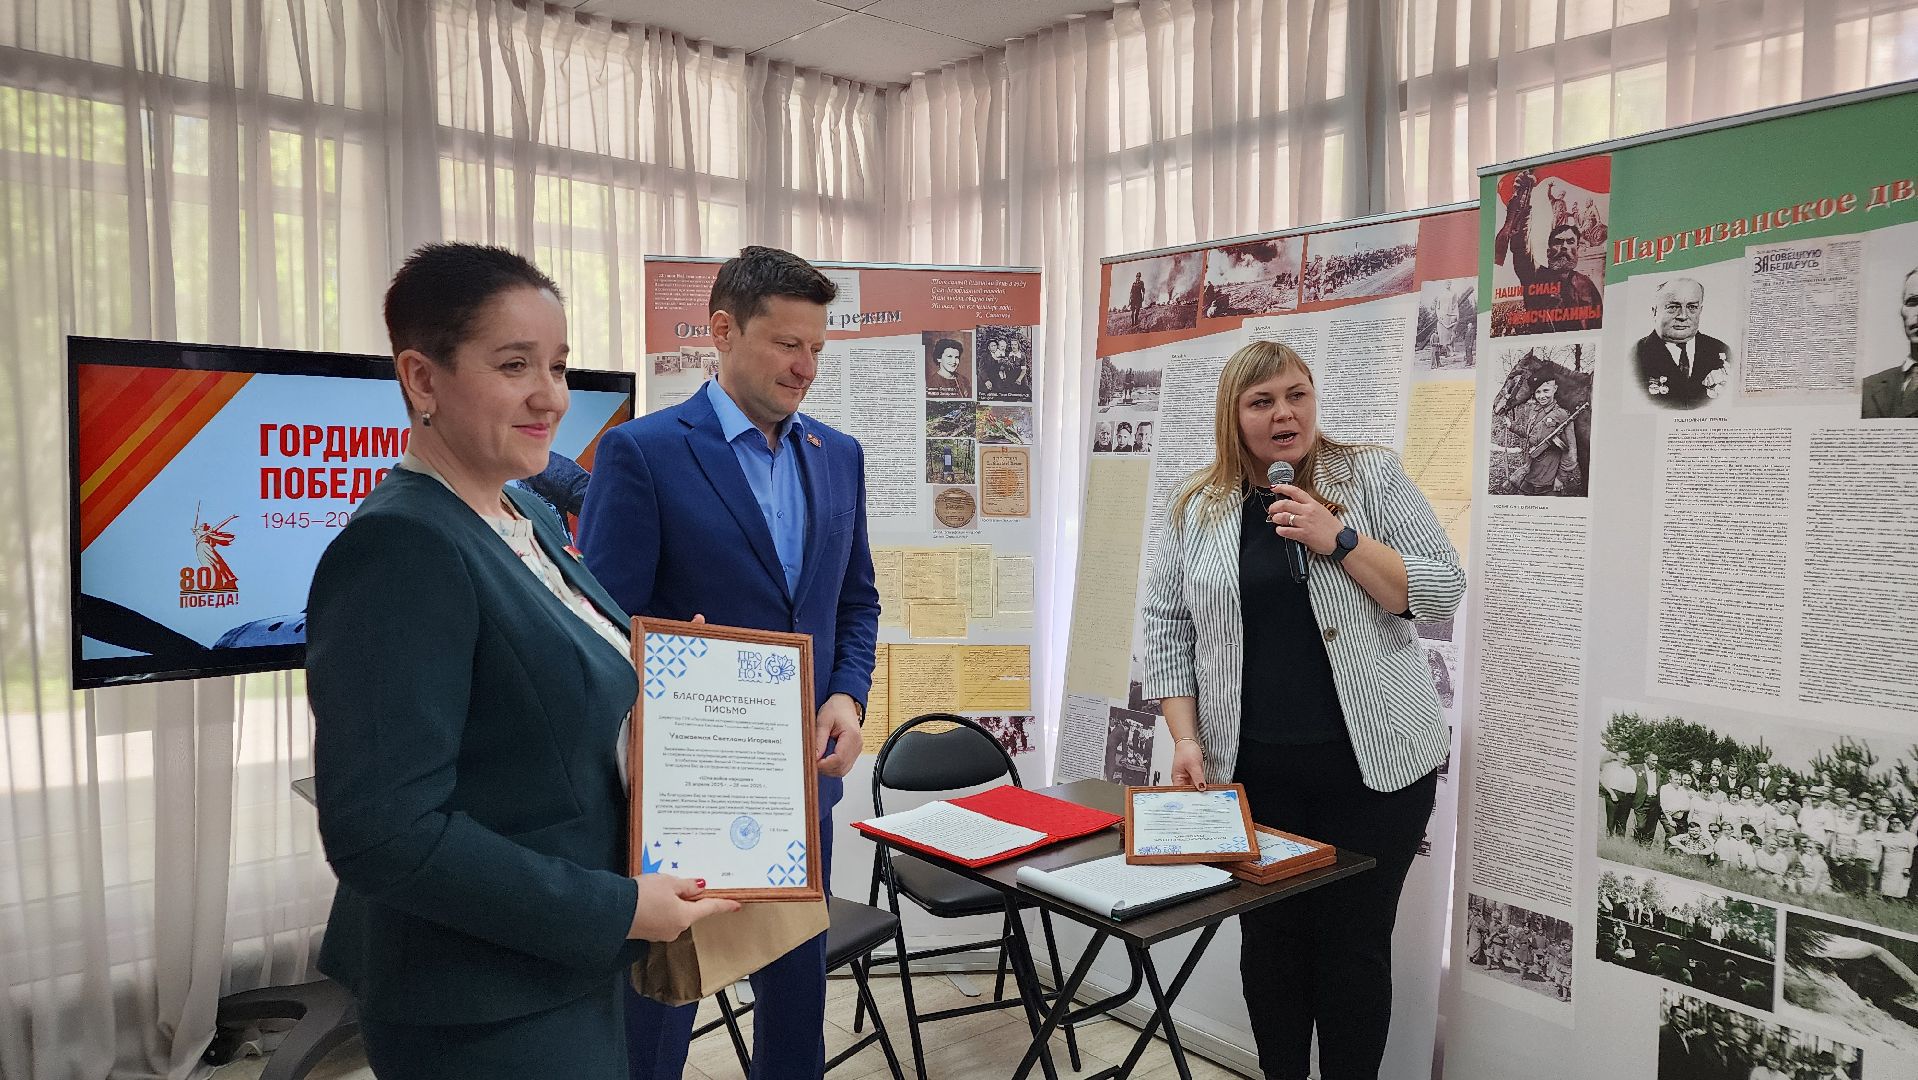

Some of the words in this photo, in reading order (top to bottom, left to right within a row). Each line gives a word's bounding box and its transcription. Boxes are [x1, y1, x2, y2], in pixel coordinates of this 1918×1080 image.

[1612, 192, 1858, 266] Партизанское
[1865, 179, 1918, 212] дв
[1495, 285, 1524, 299] НАШИ
[1528, 281, 1561, 296] СИЛЫ
[840, 310, 902, 328] режим
[180, 567, 212, 591] 80
[180, 593, 239, 609] ПОБЕДА!
[673, 692, 776, 706] БЛАГОДАРСТВЕННОЕ
[704, 705, 747, 715] ПИСЬМО
